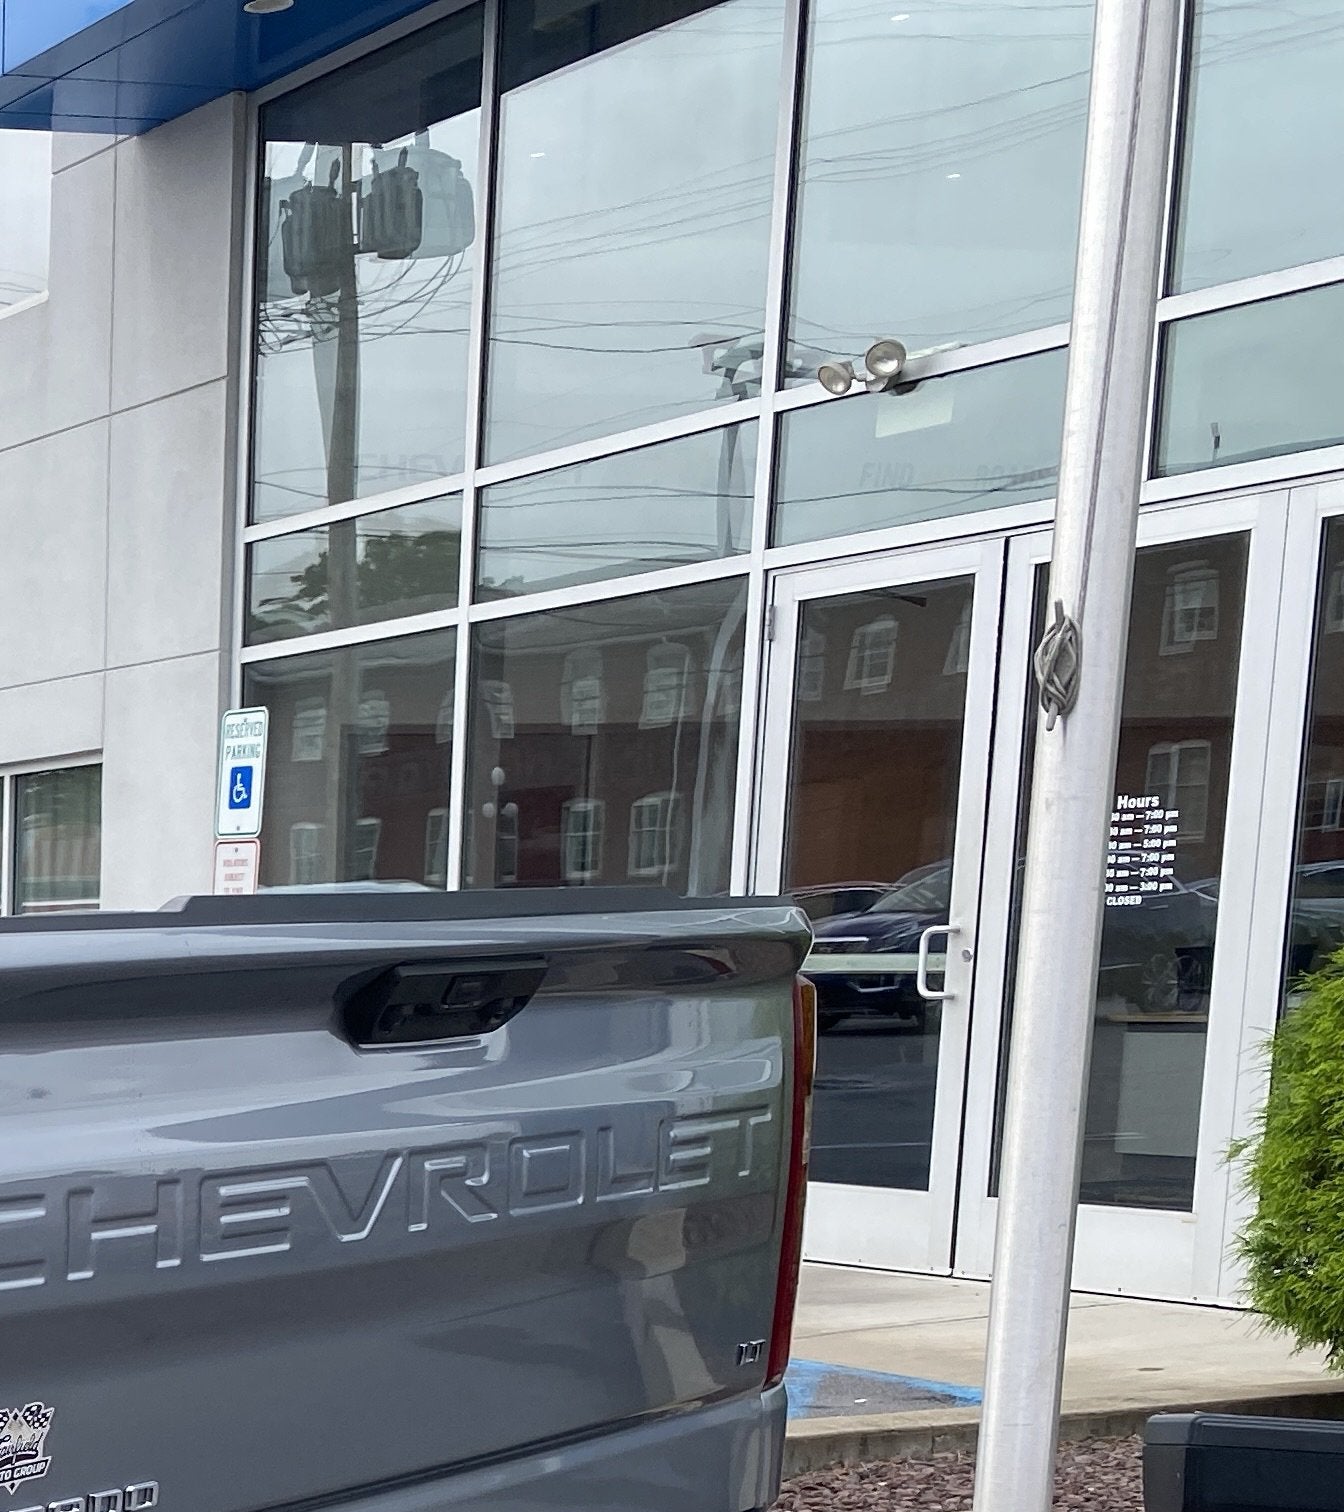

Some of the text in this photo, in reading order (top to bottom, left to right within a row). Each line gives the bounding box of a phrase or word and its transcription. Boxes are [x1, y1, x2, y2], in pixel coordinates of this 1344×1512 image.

[225, 721, 264, 739] RESERVED
[225, 743, 261, 761] PARKING
[1117, 795, 1160, 810] Hours
[1145, 810, 1164, 820] 7:00
[1144, 824, 1163, 834] 7:00
[1141, 853, 1160, 862] 7:00
[1140, 867, 1159, 878] 7:00
[1106, 895, 1143, 906] CLOSED
[737, 1339, 767, 1367] LT
[13, 1461, 46, 1478] GROUP
